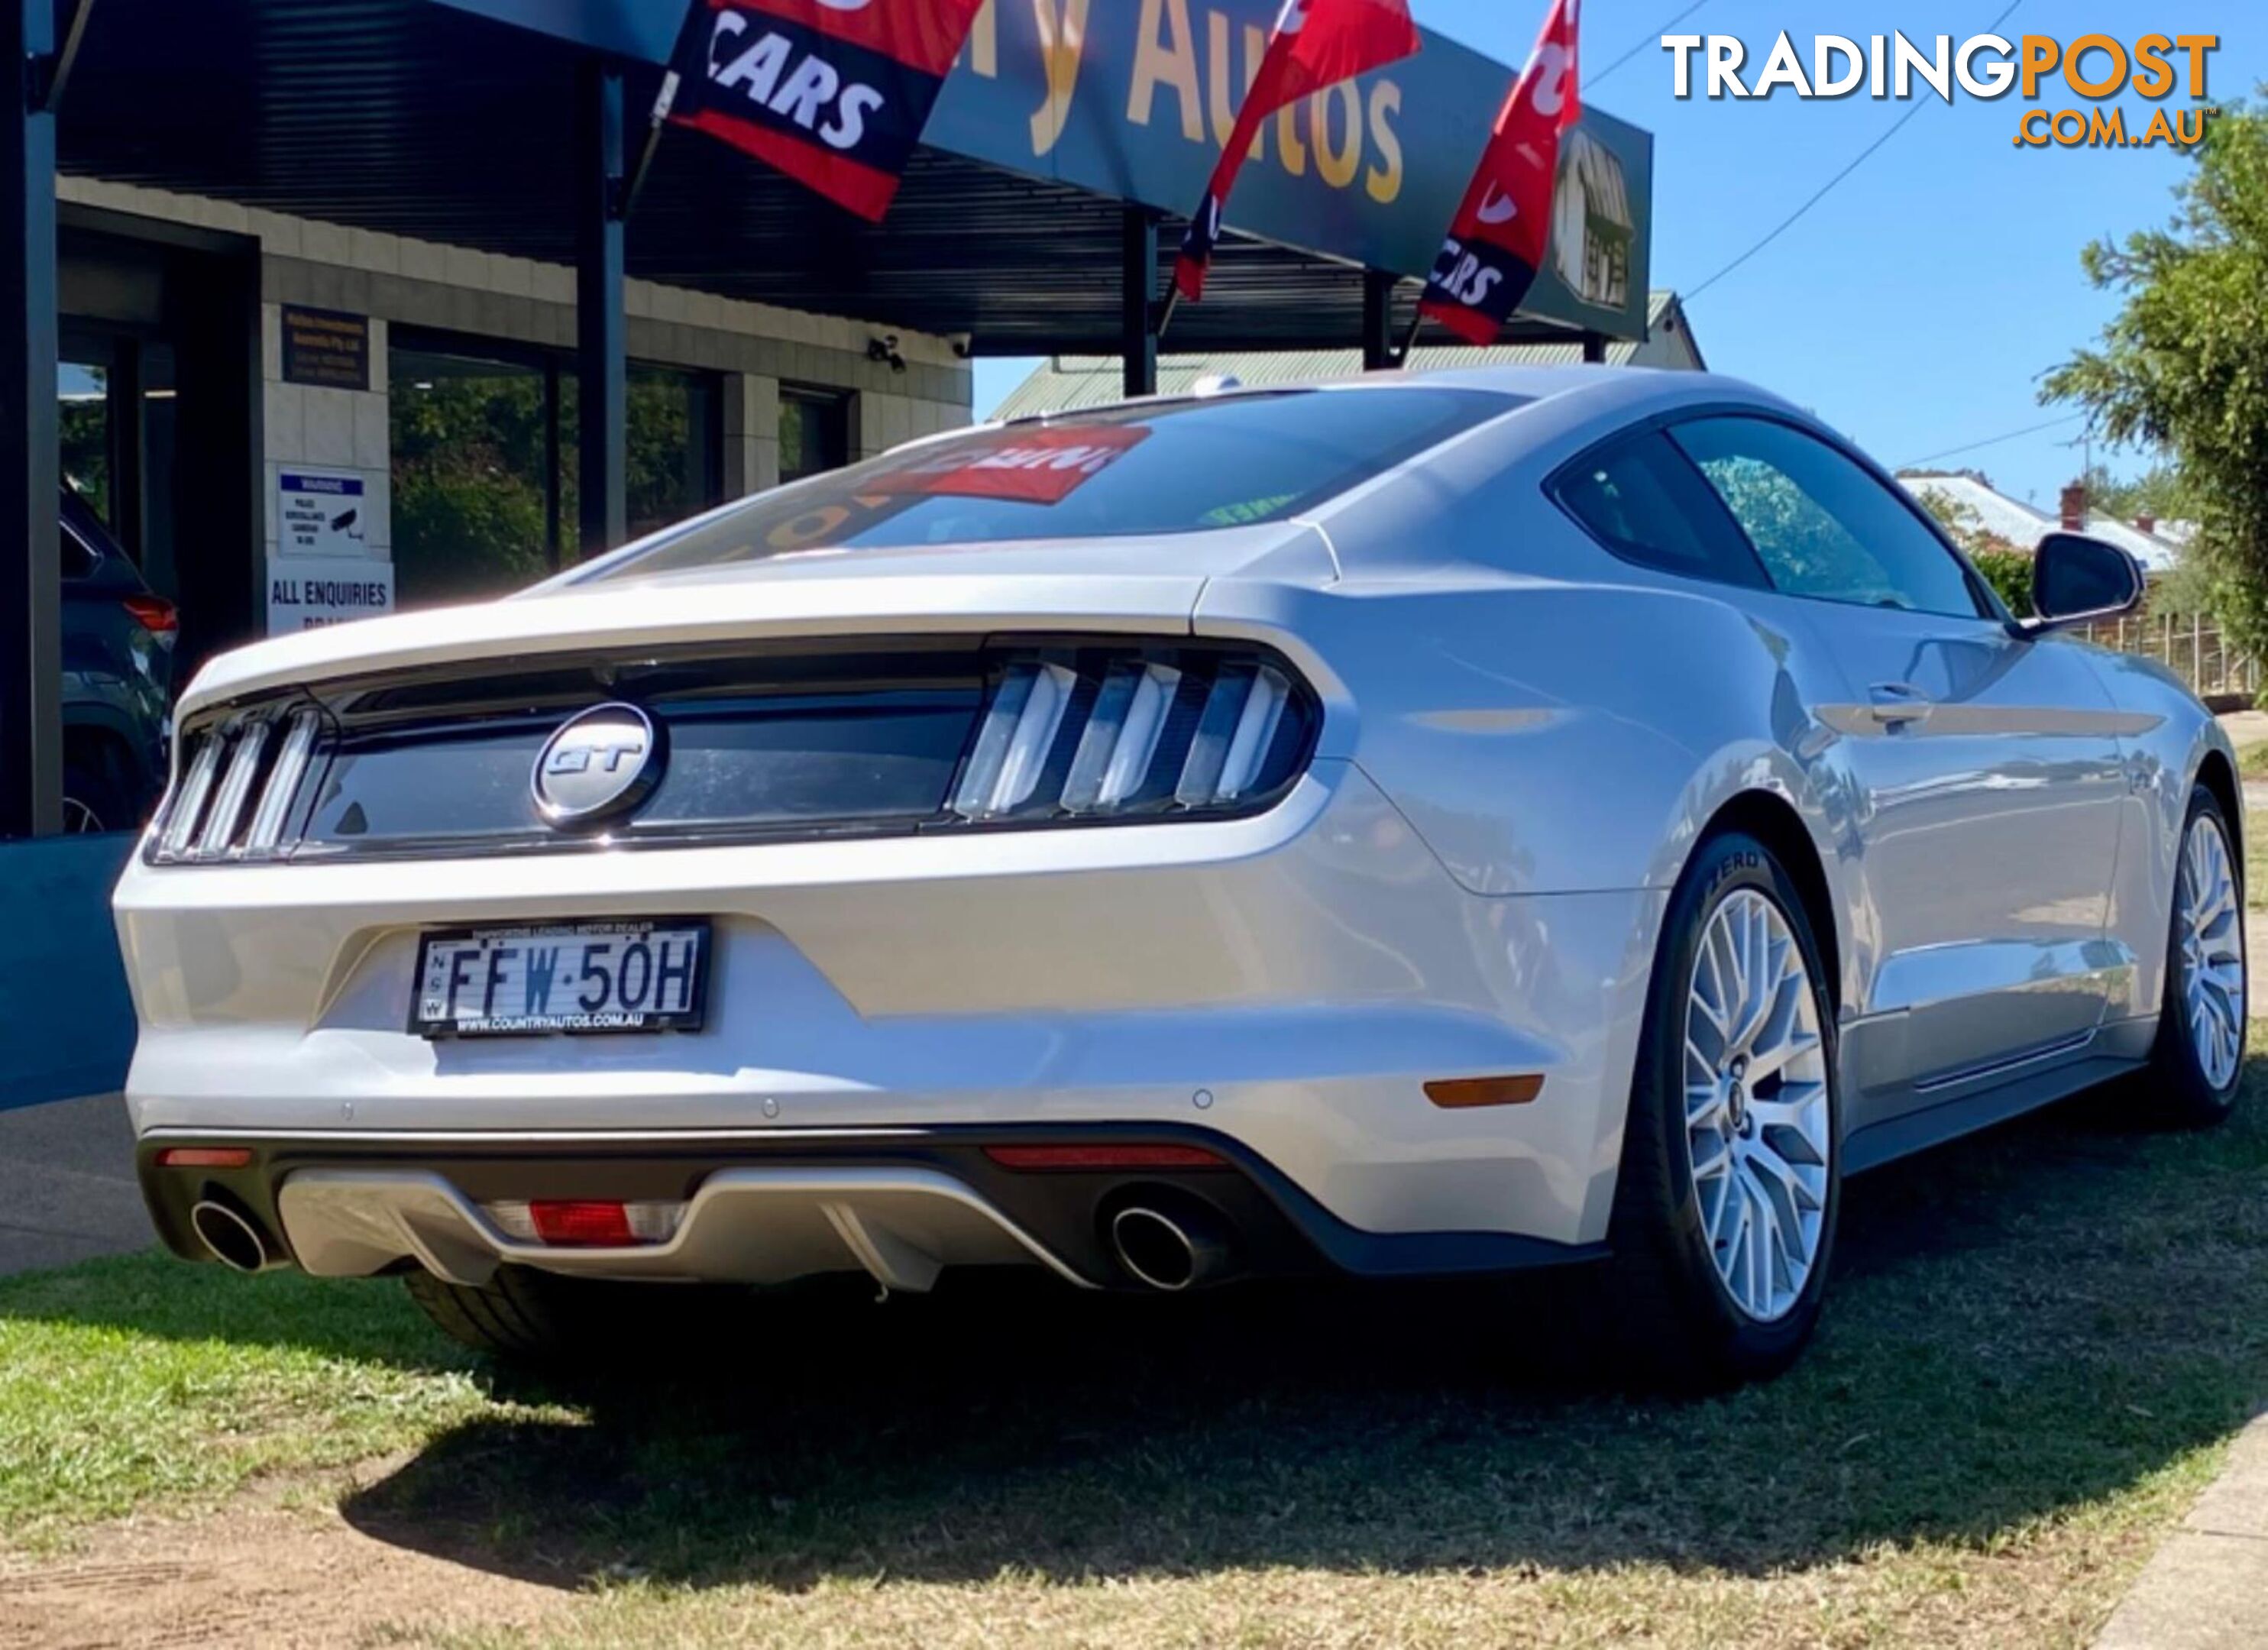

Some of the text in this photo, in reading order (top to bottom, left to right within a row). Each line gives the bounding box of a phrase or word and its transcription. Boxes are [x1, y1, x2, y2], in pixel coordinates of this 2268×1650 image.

[707, 10, 885, 149] CARS
[272, 580, 387, 608] ALL ENQUIRIES
[547, 743, 643, 775] GT
